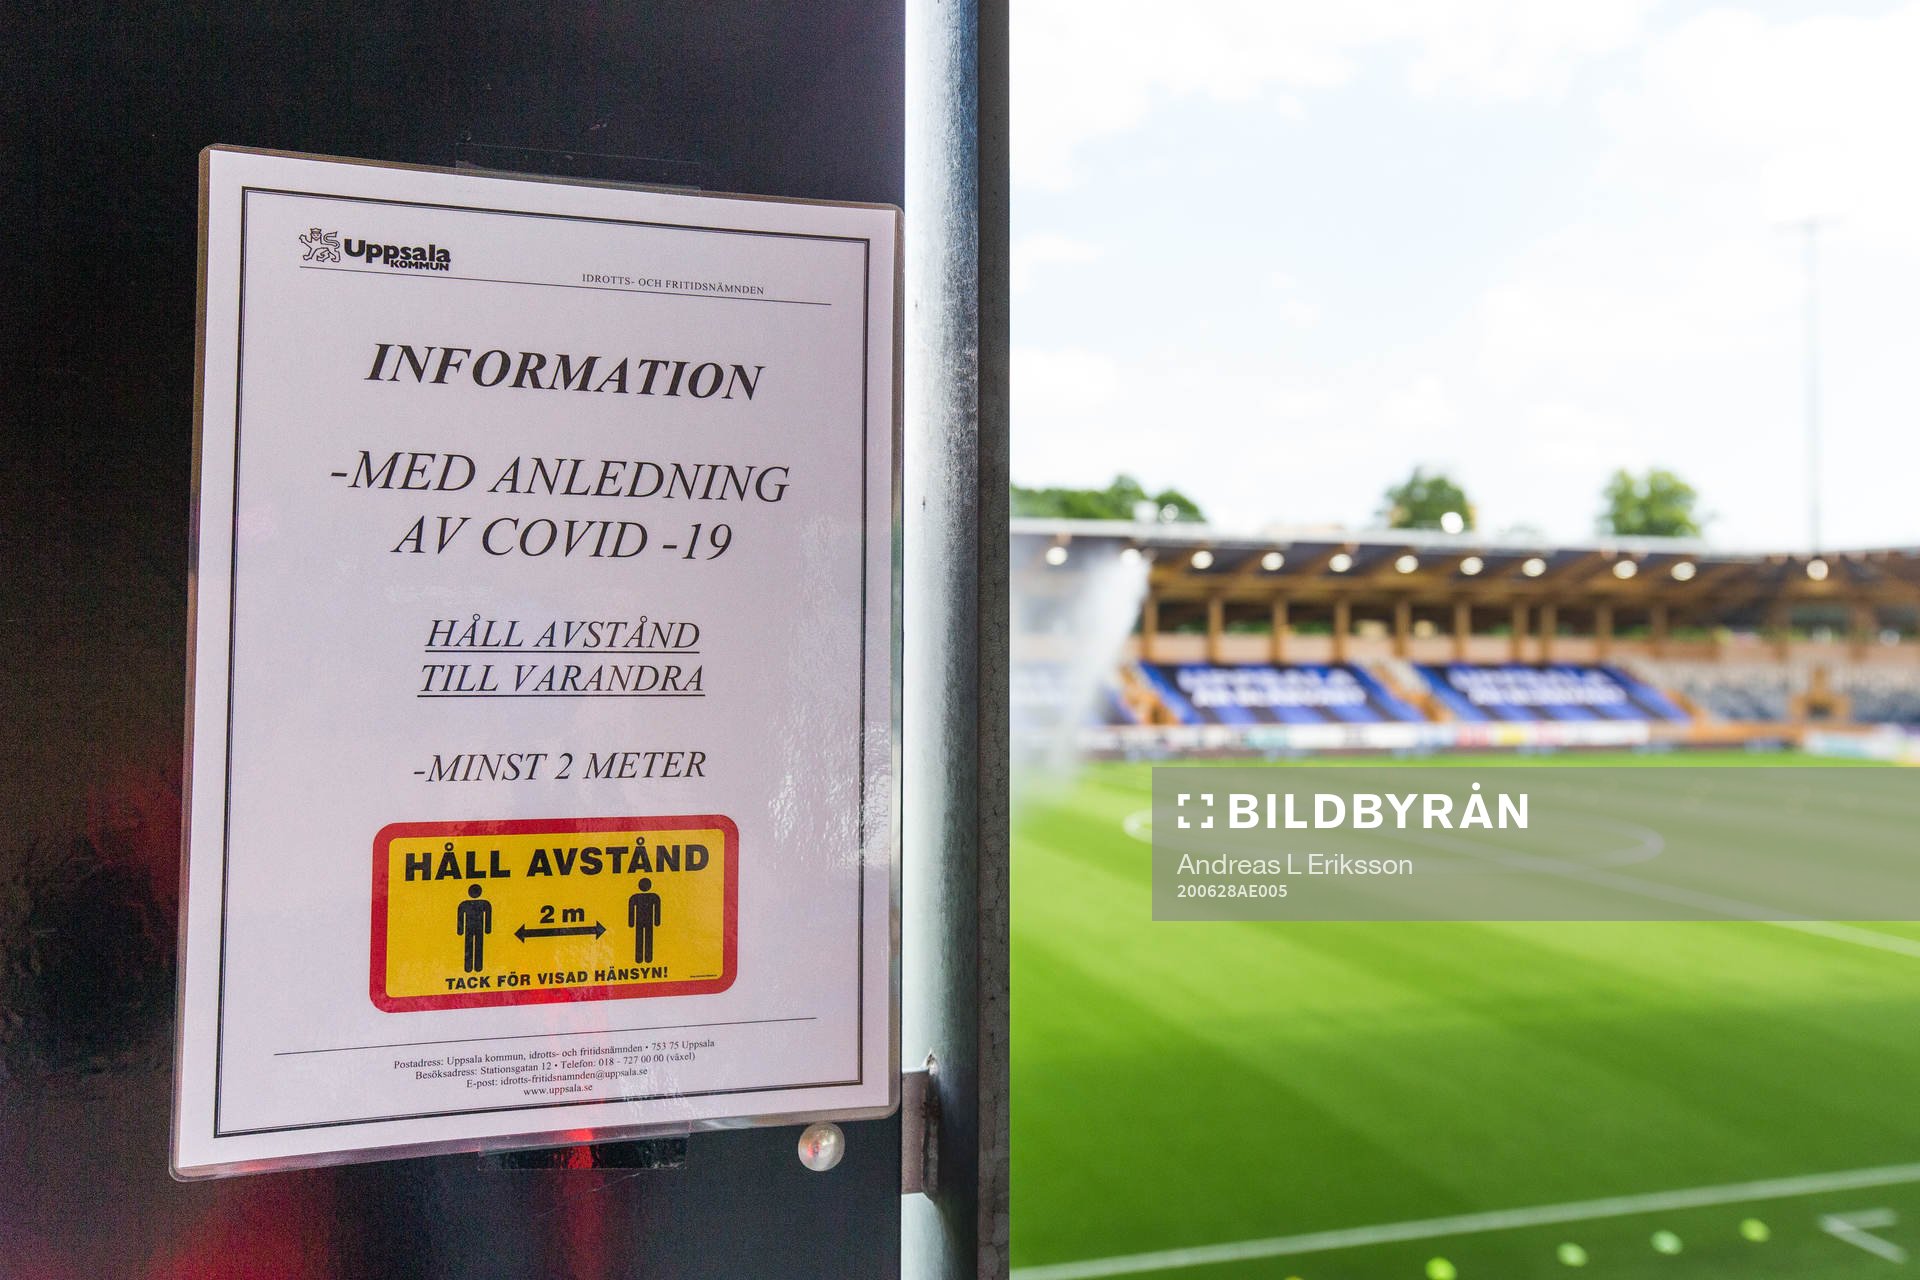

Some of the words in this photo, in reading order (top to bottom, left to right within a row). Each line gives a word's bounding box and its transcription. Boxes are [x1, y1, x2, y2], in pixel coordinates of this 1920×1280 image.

[344, 238, 451, 264] Uppsala
[390, 259, 449, 271] KOMMUN
[582, 273, 635, 286] IDROTTS-
[638, 278, 662, 288] OCH
[665, 280, 764, 295] FRITIDSNÄMNDEN
[363, 342, 766, 401] INFORMATION
[330, 449, 476, 492] -MED
[487, 455, 790, 503] ANLEDNING
[390, 514, 472, 556] AV
[482, 516, 648, 559] COVID
[662, 522, 733, 561] -19
[424, 613, 524, 648] HÅLL
[532, 615, 700, 649] AVSTÅND
[420, 664, 499, 692] TILL
[513, 664, 703, 692] VARANDRA
[413, 752, 548, 783] -MINST
[554, 752, 574, 780] 2
[582, 750, 707, 780] METER
[404, 841, 511, 882] HÅLL
[526, 836, 710, 878] AVSTÅND
[539, 905, 555, 924] 2
[562, 906, 585, 923] m
[445, 975, 490, 990] TACK
[497, 970, 531, 987] FÖR
[537, 970, 588, 984] VISAD
[594, 966, 668, 982] HÄNSYN!
[394, 1058, 444, 1070] Postadress:
[447, 1055, 483, 1067] Uppsala
[485, 1053, 526, 1064] kommun,
[529, 1050, 560, 1060] idrotts-
[562, 1048, 577, 1057] och
[580, 1044, 643, 1057] fritidsnämnden
[651, 1042, 667, 1050] 753
[669, 1041, 679, 1050] 75
[681, 1039, 715, 1051] Uppsala
[415, 1069, 478, 1080] Besöksadress:
[480, 1064, 539, 1076] Stationsgatan
[541, 1062, 552, 1071] 12
[561, 1059, 596, 1069] Telefon:
[598, 1057, 614, 1067] 018
[623, 1056, 639, 1065] 727
[640, 1055, 652, 1063] 00
[653, 1053, 664, 1062] 00
[666, 1051, 696, 1063] (växel)
[466, 1078, 498, 1089] E-post:
[500, 1067, 648, 1086] idrotts-fritidsnamnden@uppsala.se
[523, 1084, 593, 1096] www.uppsala.se
